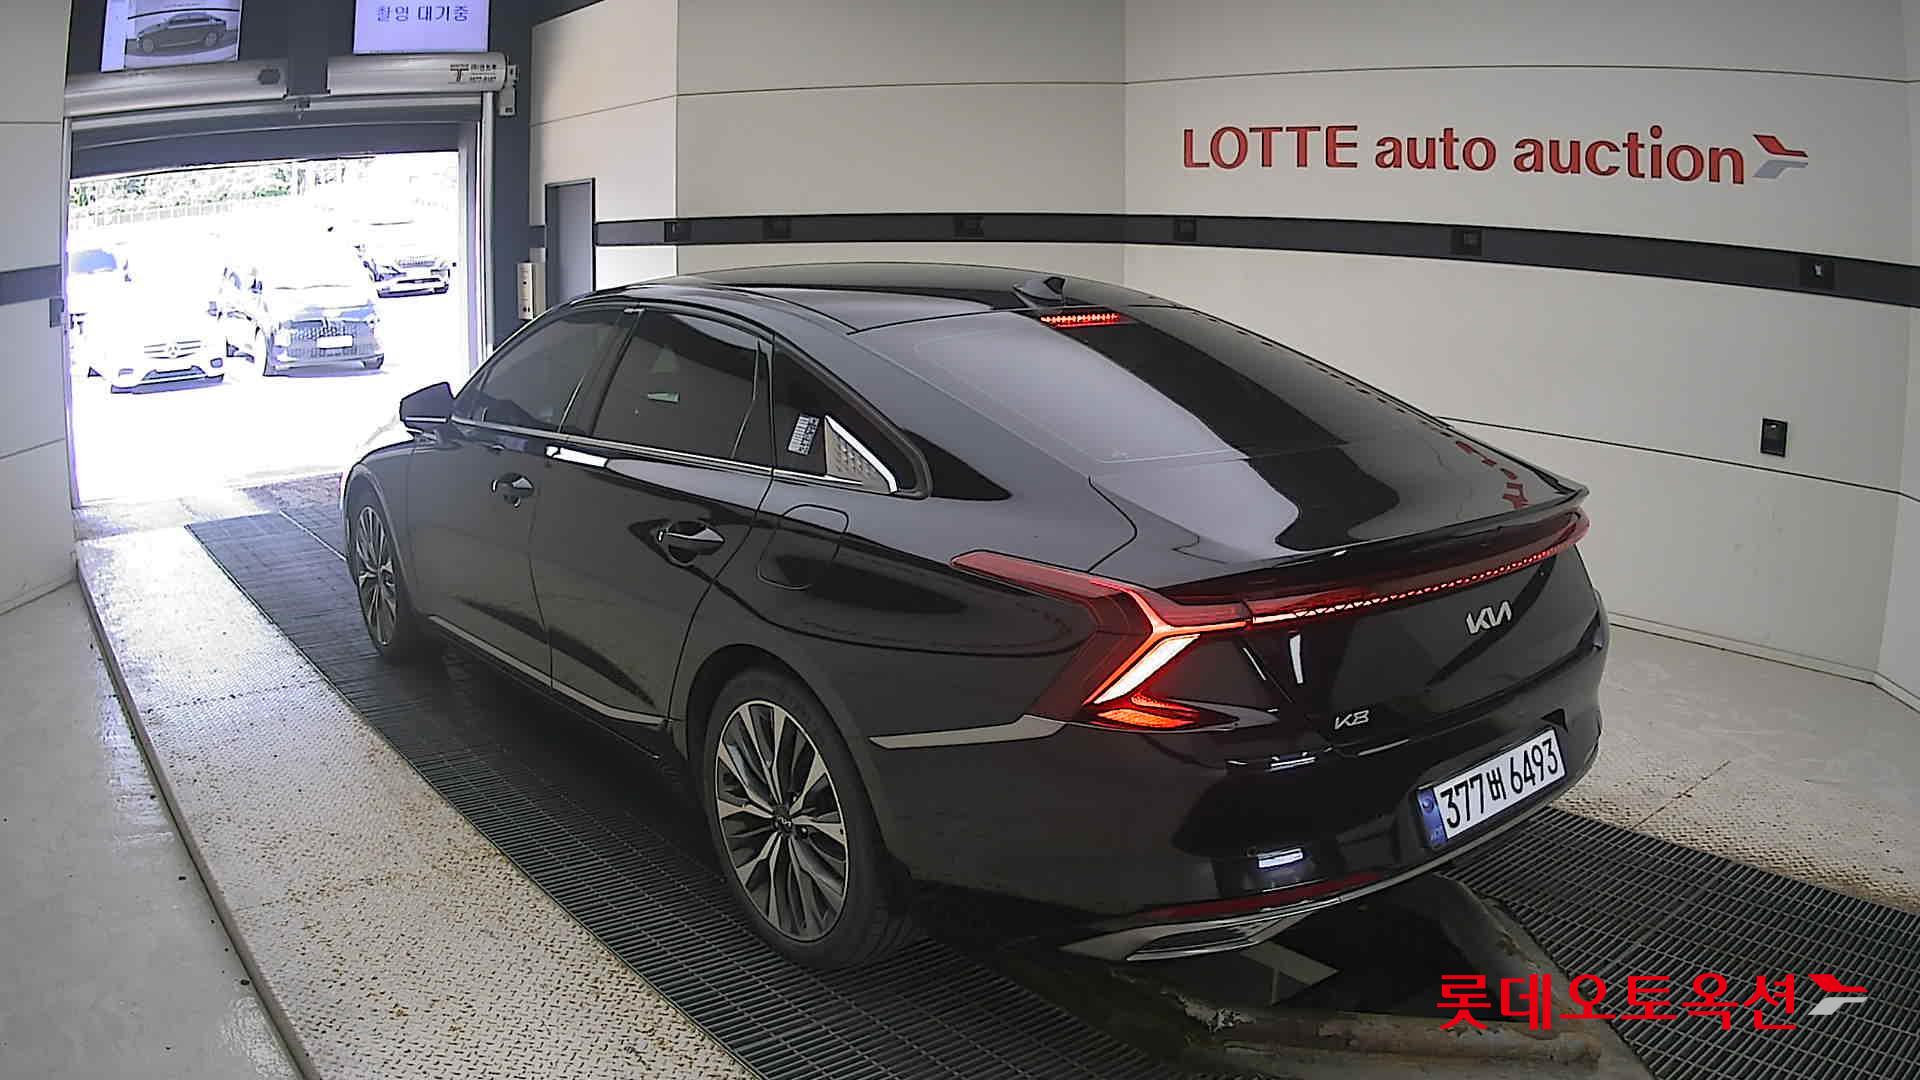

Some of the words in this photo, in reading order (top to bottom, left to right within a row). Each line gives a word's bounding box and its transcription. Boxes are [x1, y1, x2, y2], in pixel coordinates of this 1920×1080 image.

[417, 5, 471, 22] 대기중
[1184, 125, 1358, 168] LOTTE
[1375, 127, 1497, 170] auto
[1513, 125, 1744, 184] auction
[1334, 709, 1370, 731] K8
[1510, 738, 1558, 795] 6493
